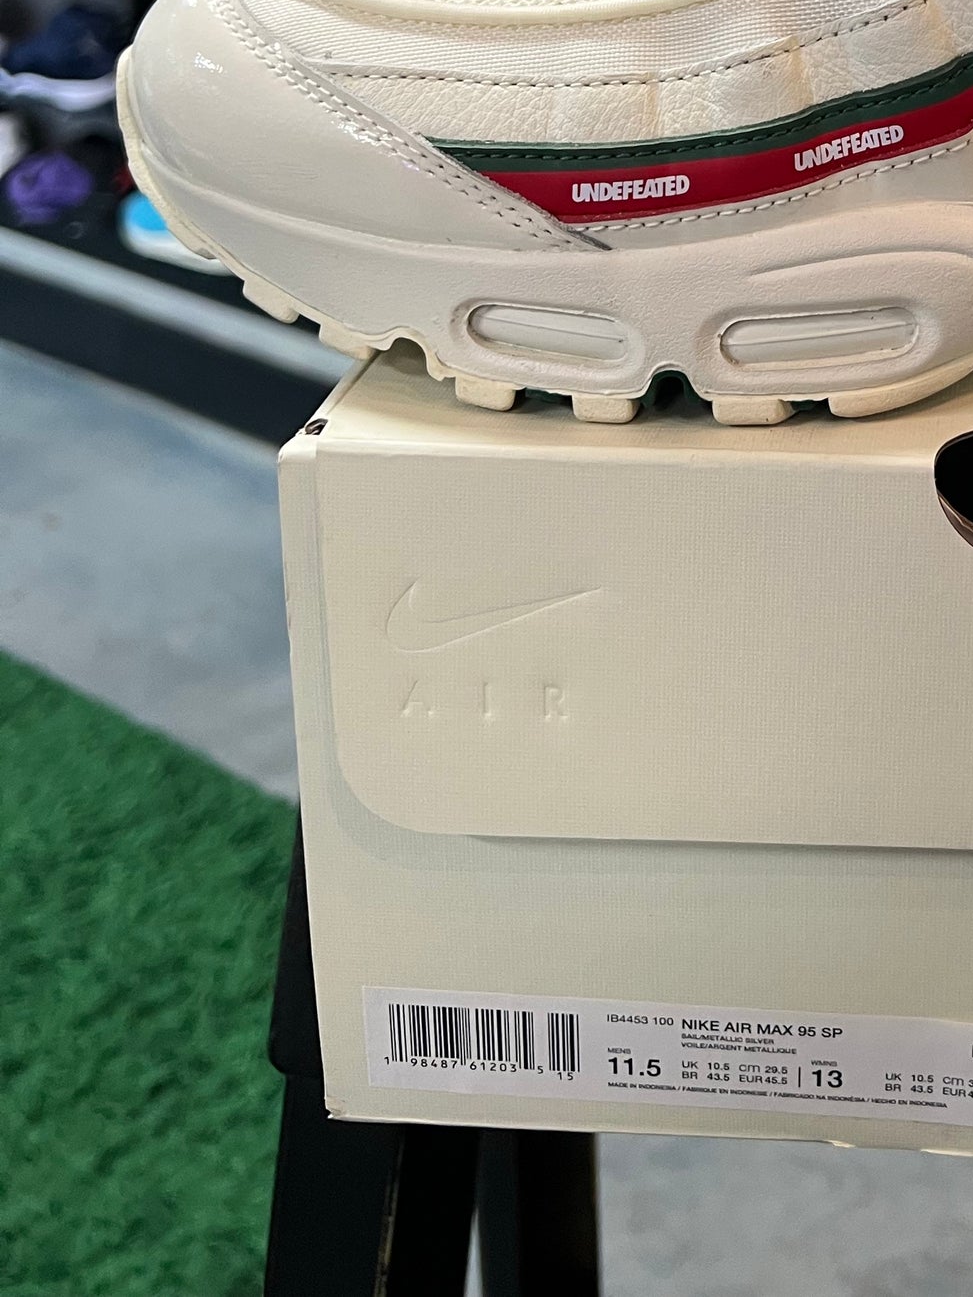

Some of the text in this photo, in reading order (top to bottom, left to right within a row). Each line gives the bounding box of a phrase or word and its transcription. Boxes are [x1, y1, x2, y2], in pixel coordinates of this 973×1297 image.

[794, 125, 904, 171] UNDEFEATED
[572, 174, 690, 203] UNDEFEATED
[401, 680, 569, 720] AIR
[606, 1014, 674, 1026] IB4453 100
[681, 1018, 844, 1039] NIKE AIR MAX 95 SP
[745, 1037, 775, 1045] SILVER
[607, 1047, 631, 1055] MENS
[744, 1046, 797, 1055] METALLIQUE
[410, 1058, 459, 1070] 98487
[469, 1061, 518, 1073] 61203
[608, 1057, 661, 1077] 11.5
[681, 1060, 788, 1075] UK 10.5 cm 29.5
[810, 1059, 838, 1067] WMNS
[556, 1071, 575, 1081] 15
[681, 1071, 788, 1085] BR 43.5 EUR 45.5
[811, 1069, 843, 1089] 13
[885, 1072, 902, 1082] UK
[911, 1074, 934, 1083] 10.5
[884, 1083, 902, 1092] BR
[910, 1084, 934, 1094] 43.5
[942, 1086, 966, 1099] EUR
